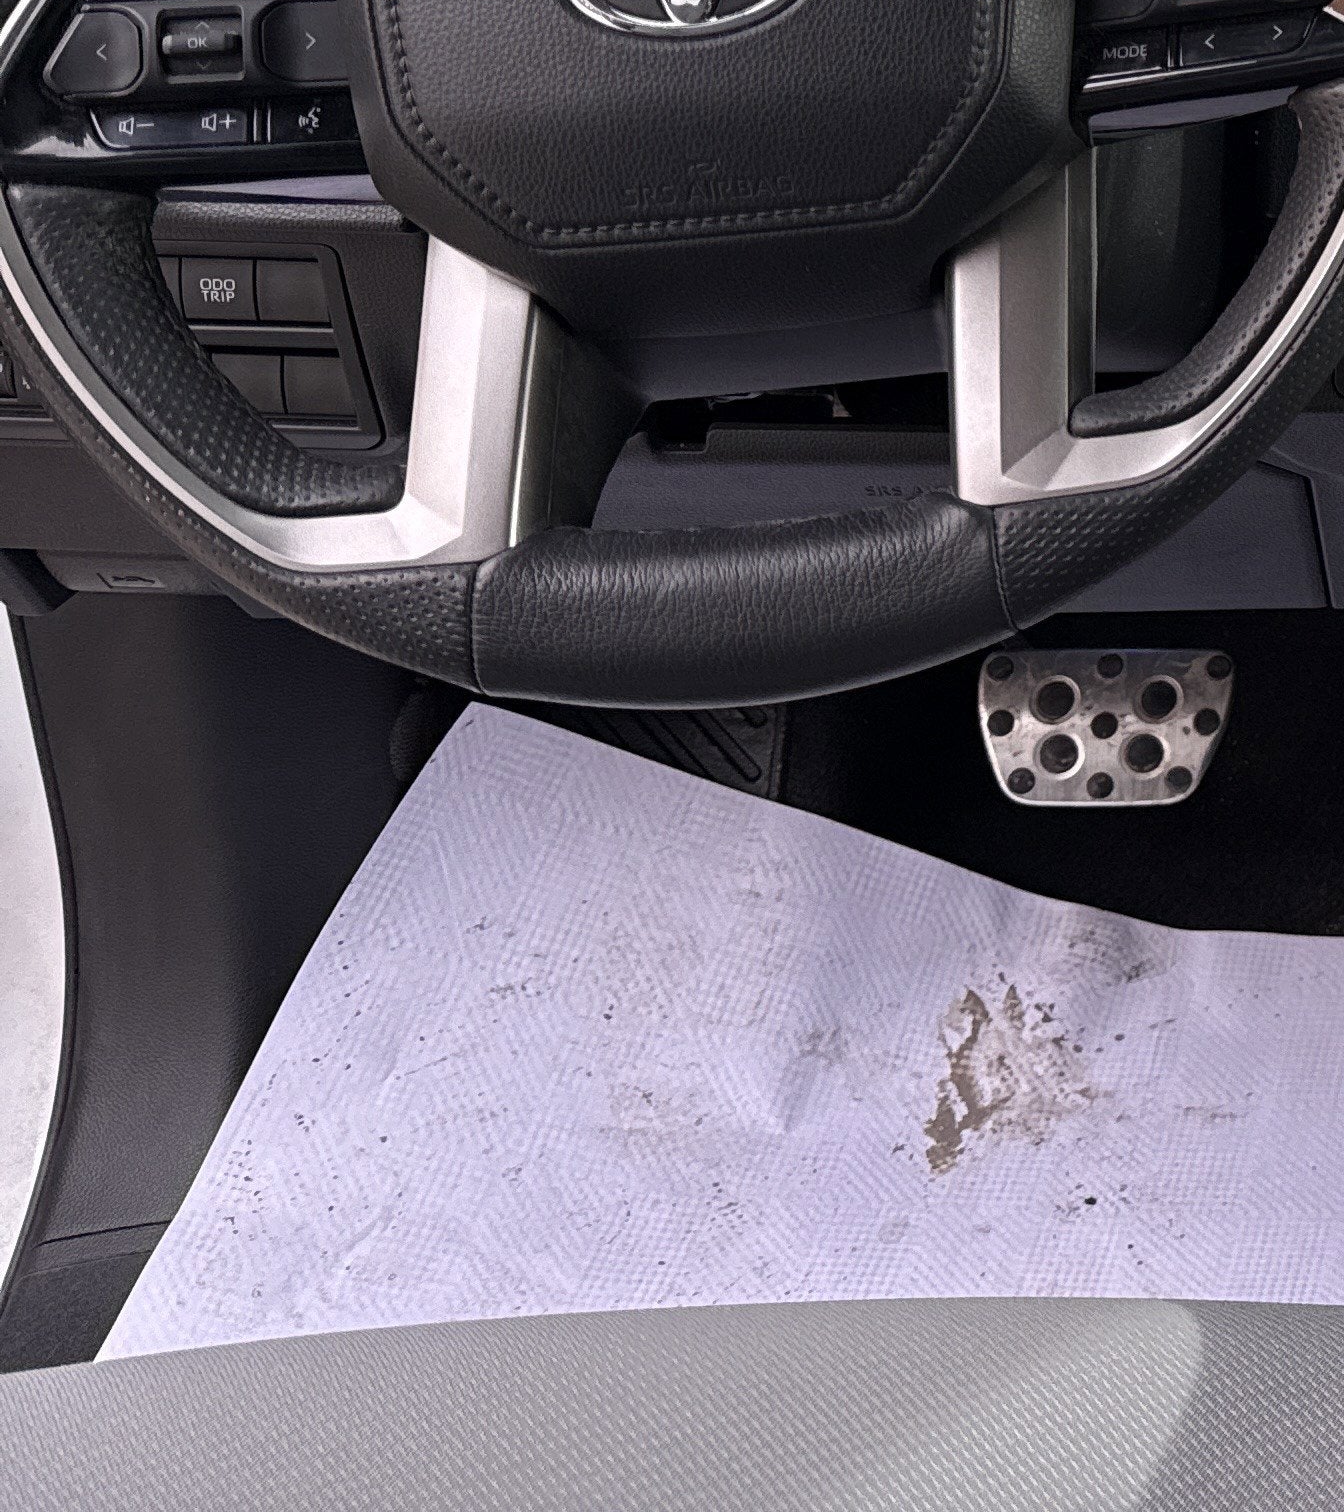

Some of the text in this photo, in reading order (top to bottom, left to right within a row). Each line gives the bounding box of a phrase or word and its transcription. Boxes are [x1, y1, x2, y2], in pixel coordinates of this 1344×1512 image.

[187, 36, 208, 49] OK
[1102, 43, 1148, 61] MODE
[199, 278, 236, 291] ODO
[201, 290, 236, 303] TRIP
